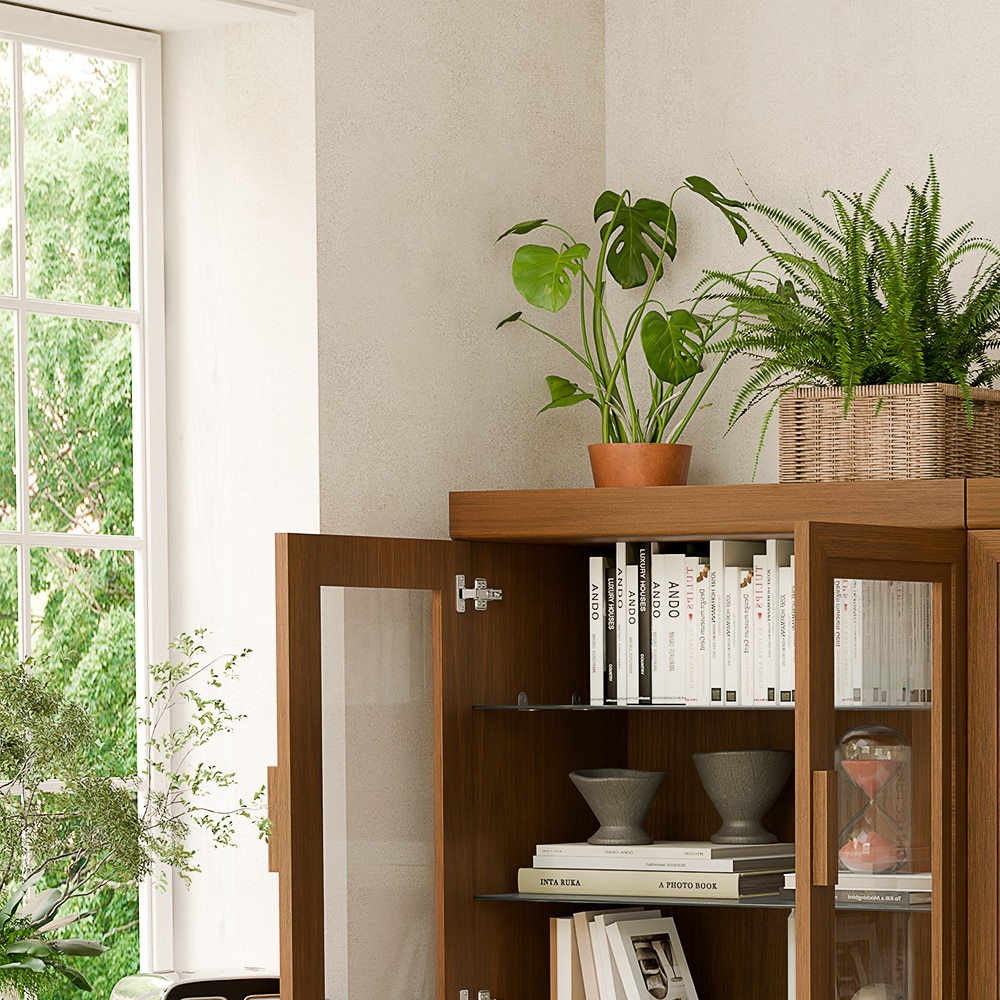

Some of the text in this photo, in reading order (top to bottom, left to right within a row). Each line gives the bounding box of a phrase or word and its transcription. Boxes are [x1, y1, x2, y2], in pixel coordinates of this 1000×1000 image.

[591, 584, 599, 621] ANDO
[628, 591, 636, 625] ANDO
[652, 582, 660, 618] ANDO
[668, 582, 679, 618] ANDO
[695, 882, 718, 890] BOOK
